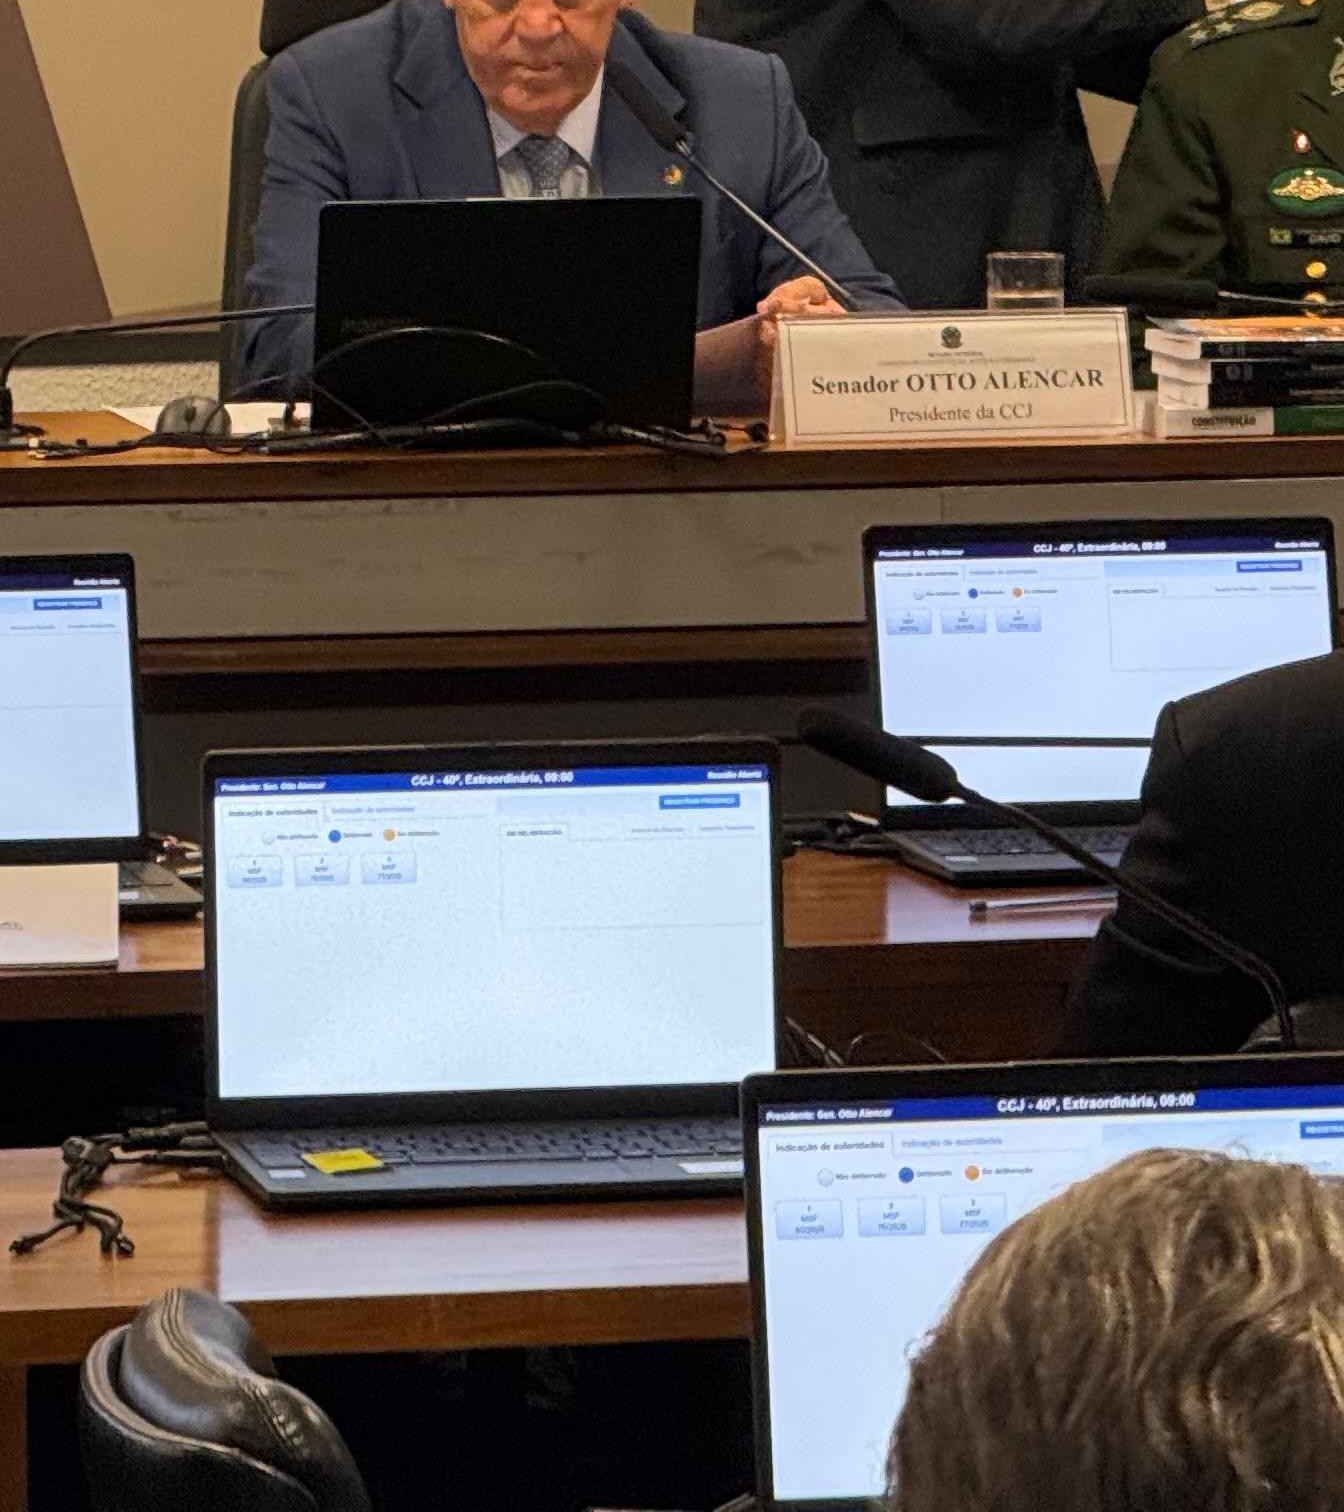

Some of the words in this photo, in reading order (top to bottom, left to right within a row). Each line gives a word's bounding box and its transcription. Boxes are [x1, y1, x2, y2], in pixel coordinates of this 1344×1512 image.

[811, 374, 899, 395] Senador
[906, 371, 977, 392] OTTO
[984, 368, 1104, 390] ALENCAR
[889, 406, 972, 424] Presidente
[975, 405, 995, 419] da
[999, 402, 1034, 419] CCJ
[411, 774, 434, 786] CCJ
[996, 1097, 1026, 1113] CCJ
[1062, 1094, 1158, 1111] Extraordinária,
[1160, 1092, 1196, 1108] 09:00
